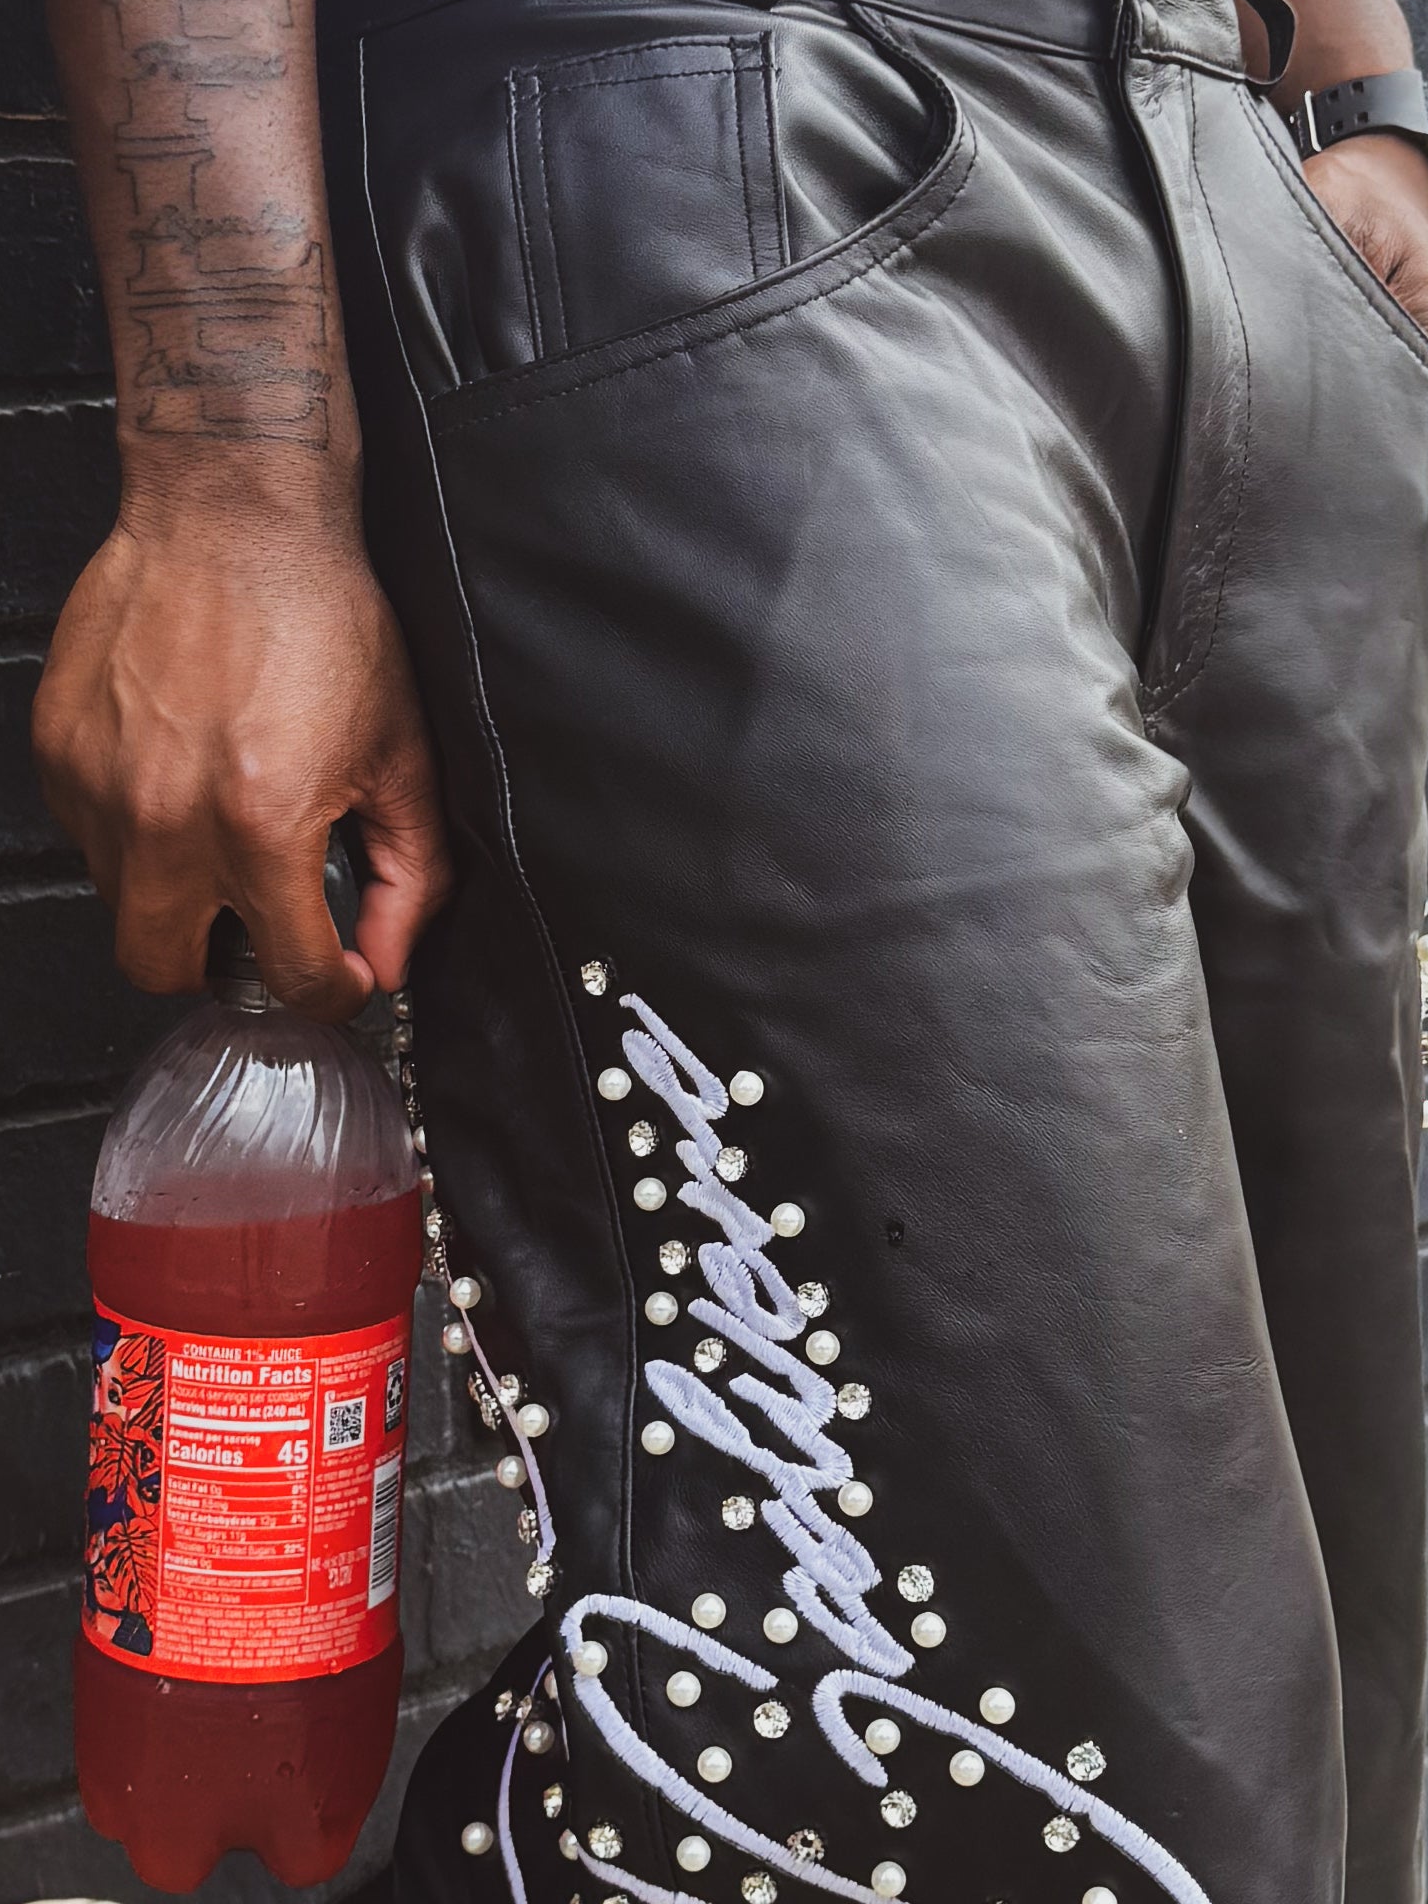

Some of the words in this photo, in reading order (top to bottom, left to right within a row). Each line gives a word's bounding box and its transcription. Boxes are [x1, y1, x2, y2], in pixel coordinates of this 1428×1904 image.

[183, 1344, 242, 1361] CONTAINS
[267, 1348, 302, 1362] JUICE
[171, 1358, 253, 1385] Nutrition
[259, 1366, 312, 1385] Facts
[170, 1397, 206, 1416] Serving
[207, 1404, 228, 1416] size
[169, 1426, 204, 1442] Amount
[205, 1433, 222, 1444] per
[224, 1435, 261, 1447] serving
[168, 1439, 244, 1466] Calories
[277, 1439, 309, 1465] 45
[168, 1478, 190, 1492] Total
[192, 1481, 208, 1494] Fat
